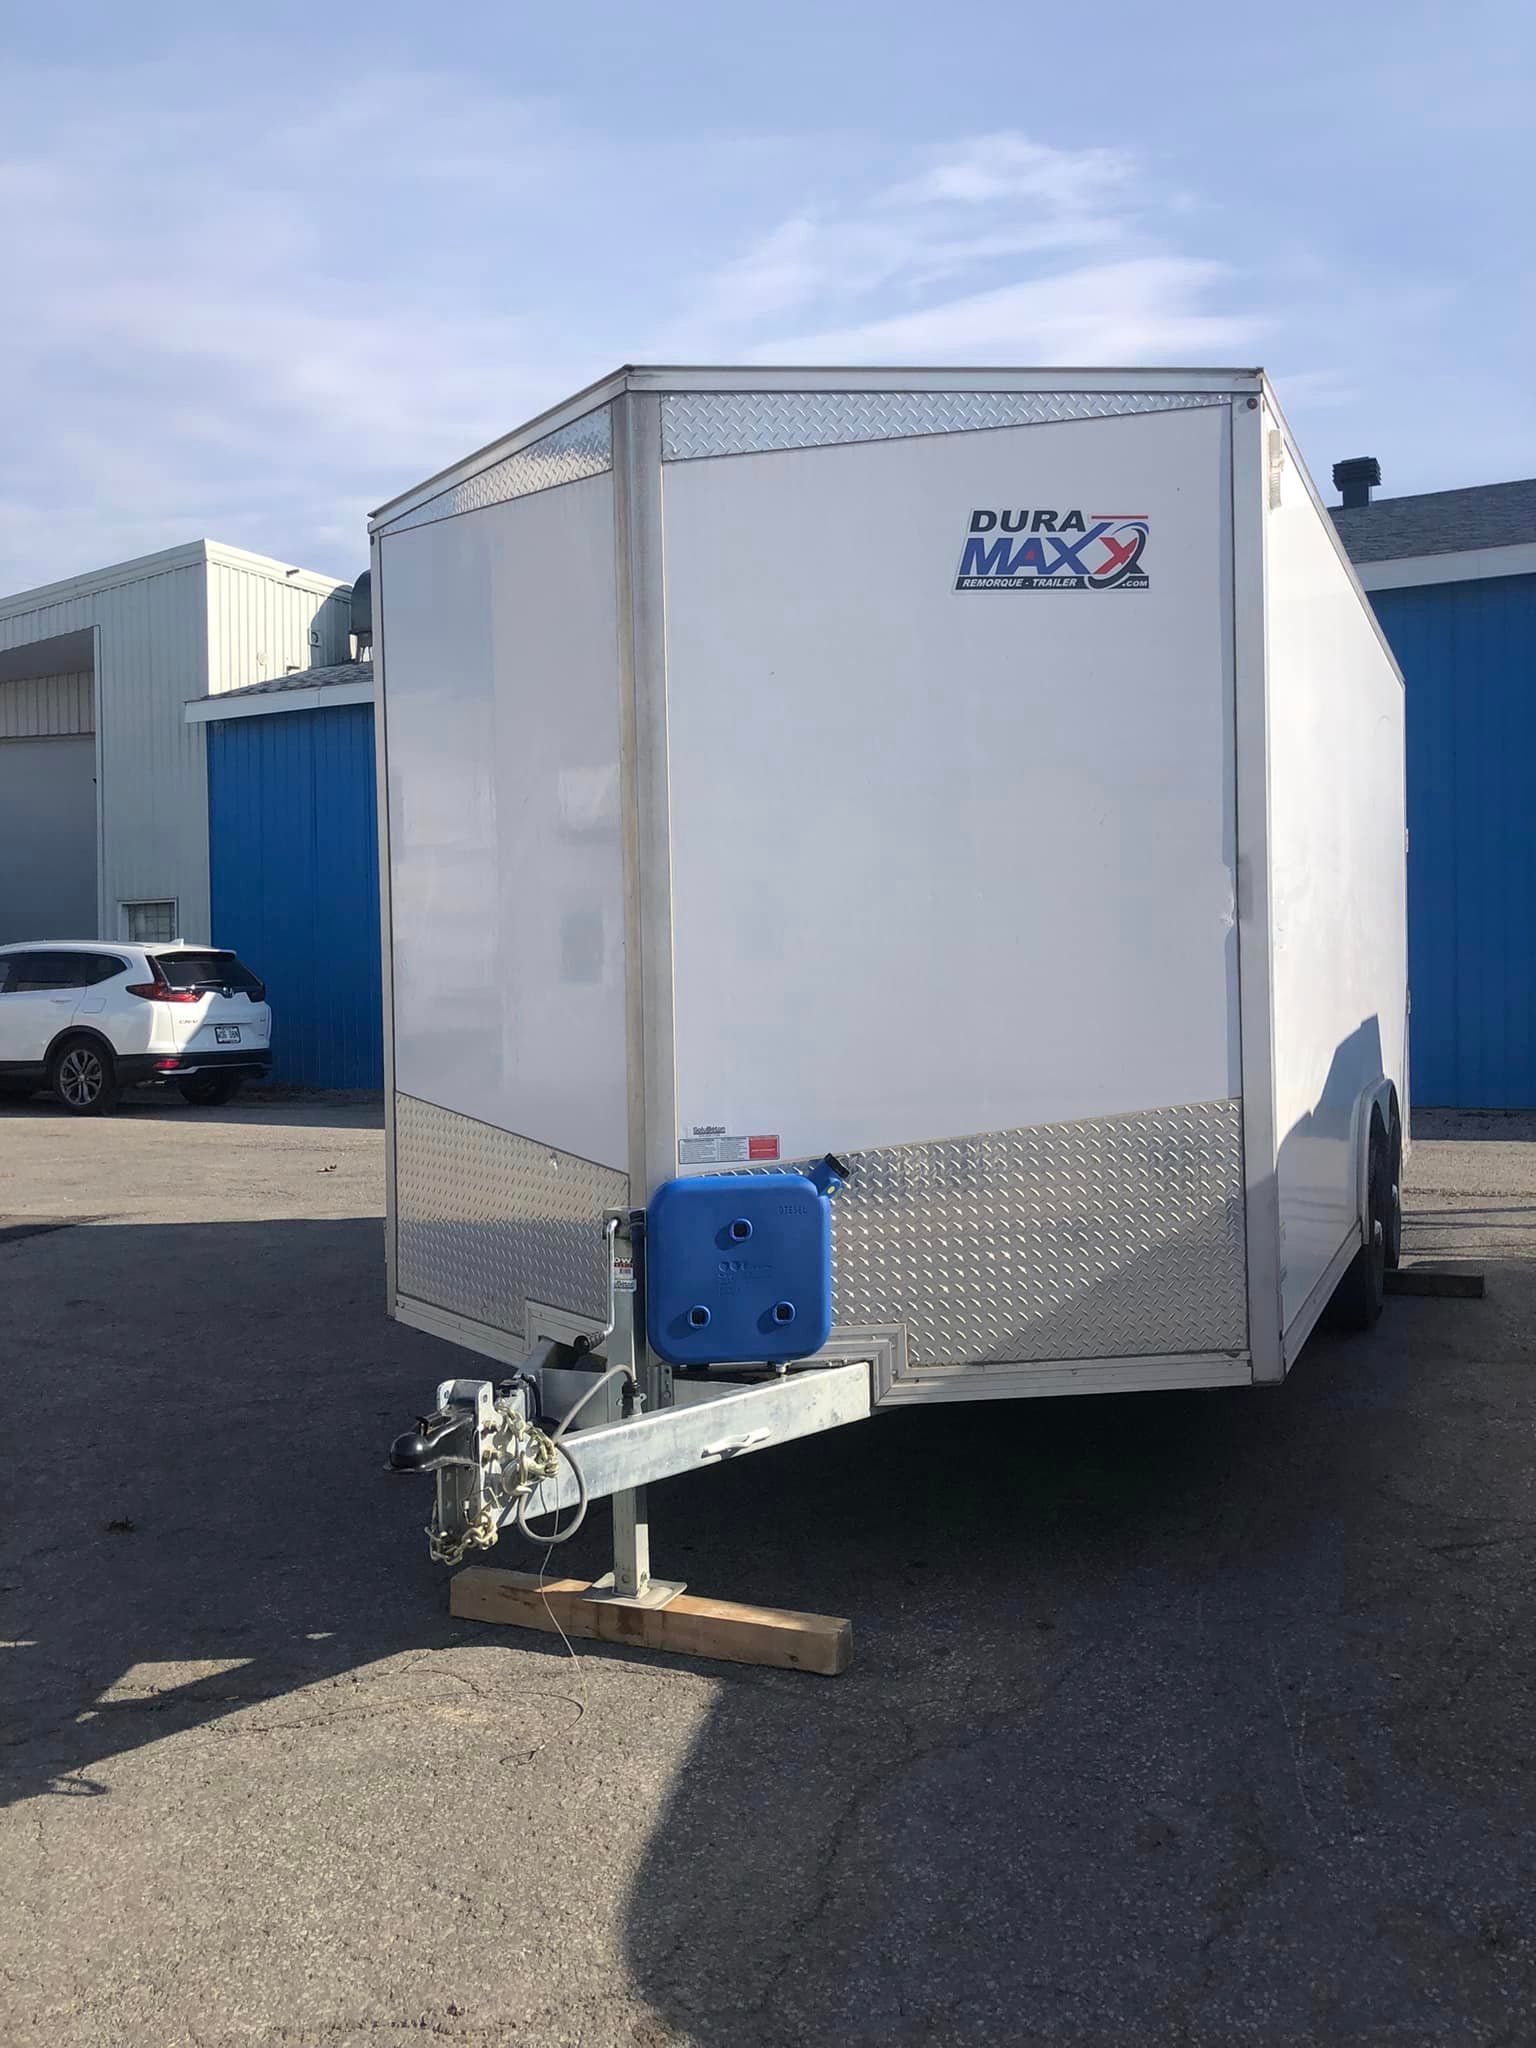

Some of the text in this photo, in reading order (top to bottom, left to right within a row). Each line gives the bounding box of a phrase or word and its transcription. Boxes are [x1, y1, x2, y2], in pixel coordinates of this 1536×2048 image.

[970, 510, 1086, 532] DURA
[959, 522, 1138, 575] MAXX
[962, 578, 1022, 587] REMORQUE
[1032, 578, 1077, 587] TRAILER
